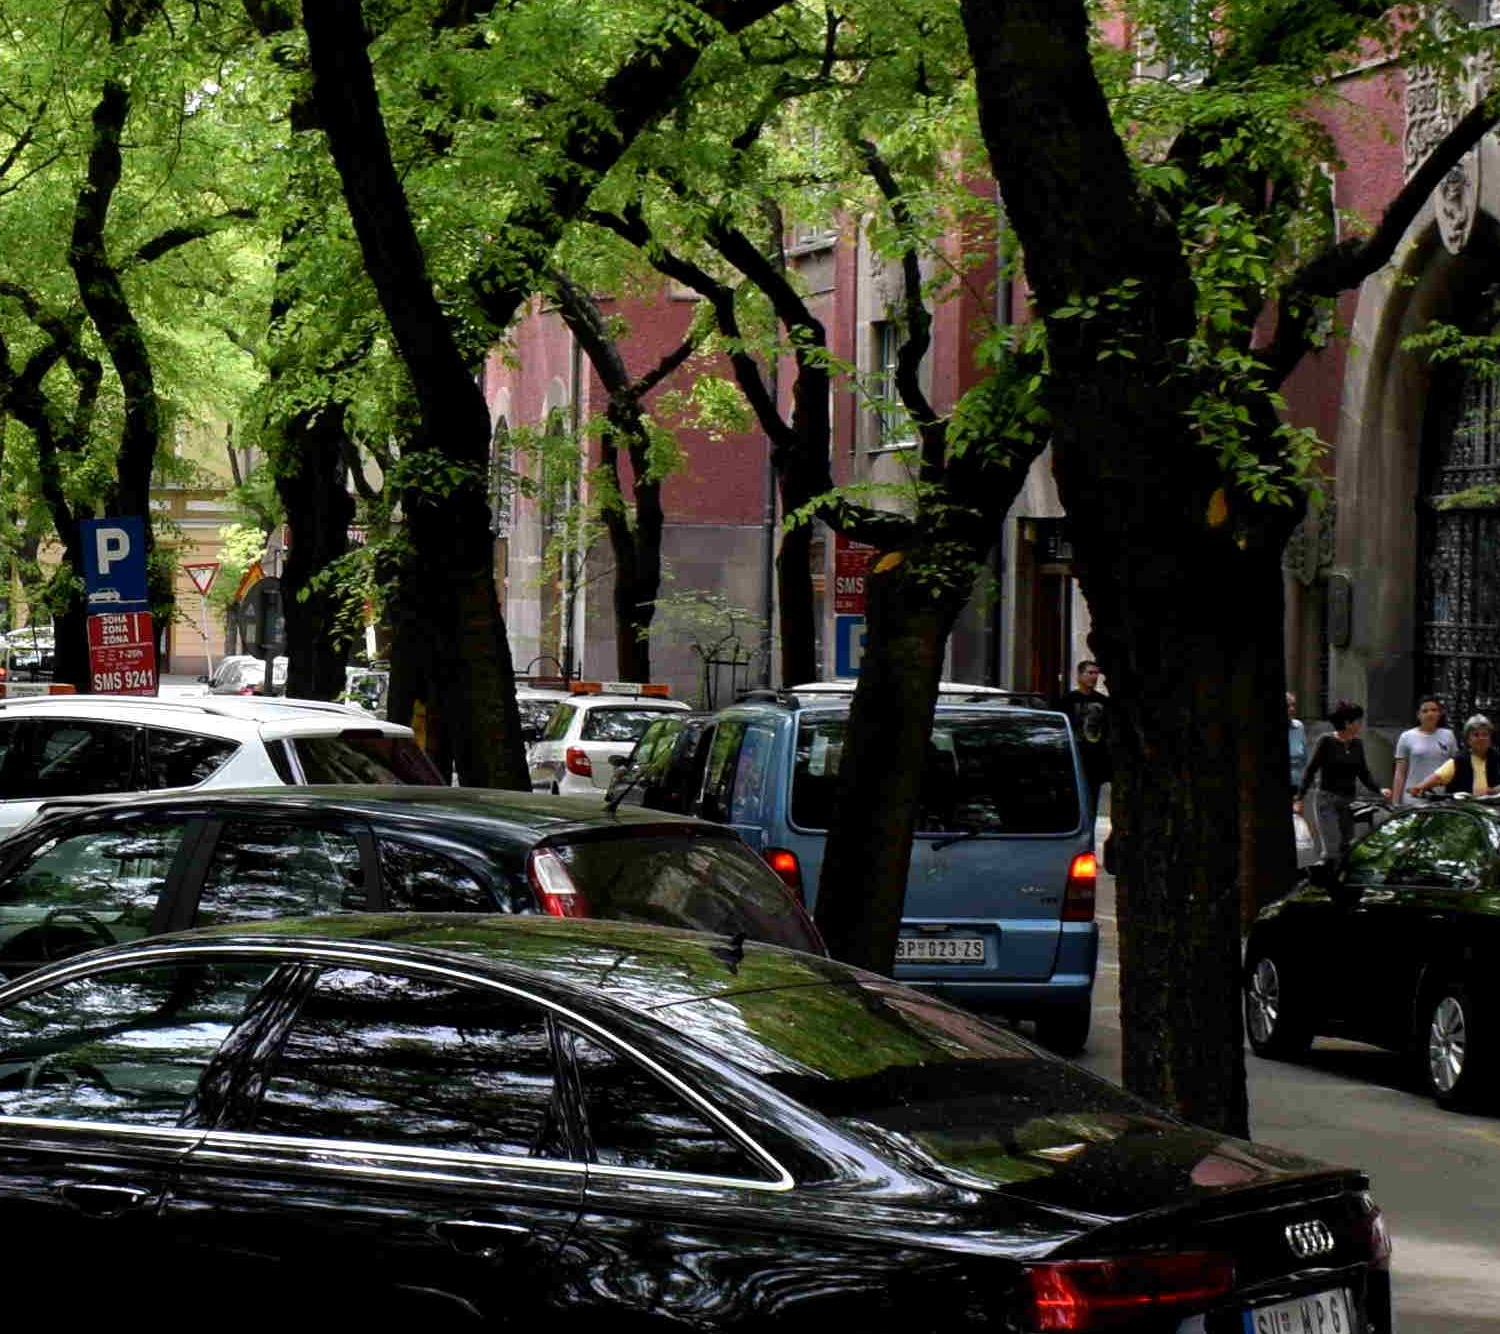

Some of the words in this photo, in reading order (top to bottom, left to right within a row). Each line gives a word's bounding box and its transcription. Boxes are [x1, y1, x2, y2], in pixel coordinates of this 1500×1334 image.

[96, 528, 130, 574] P
[836, 576, 865, 595] SMS
[94, 671, 122, 691] SMS
[125, 669, 153, 689] 9241
